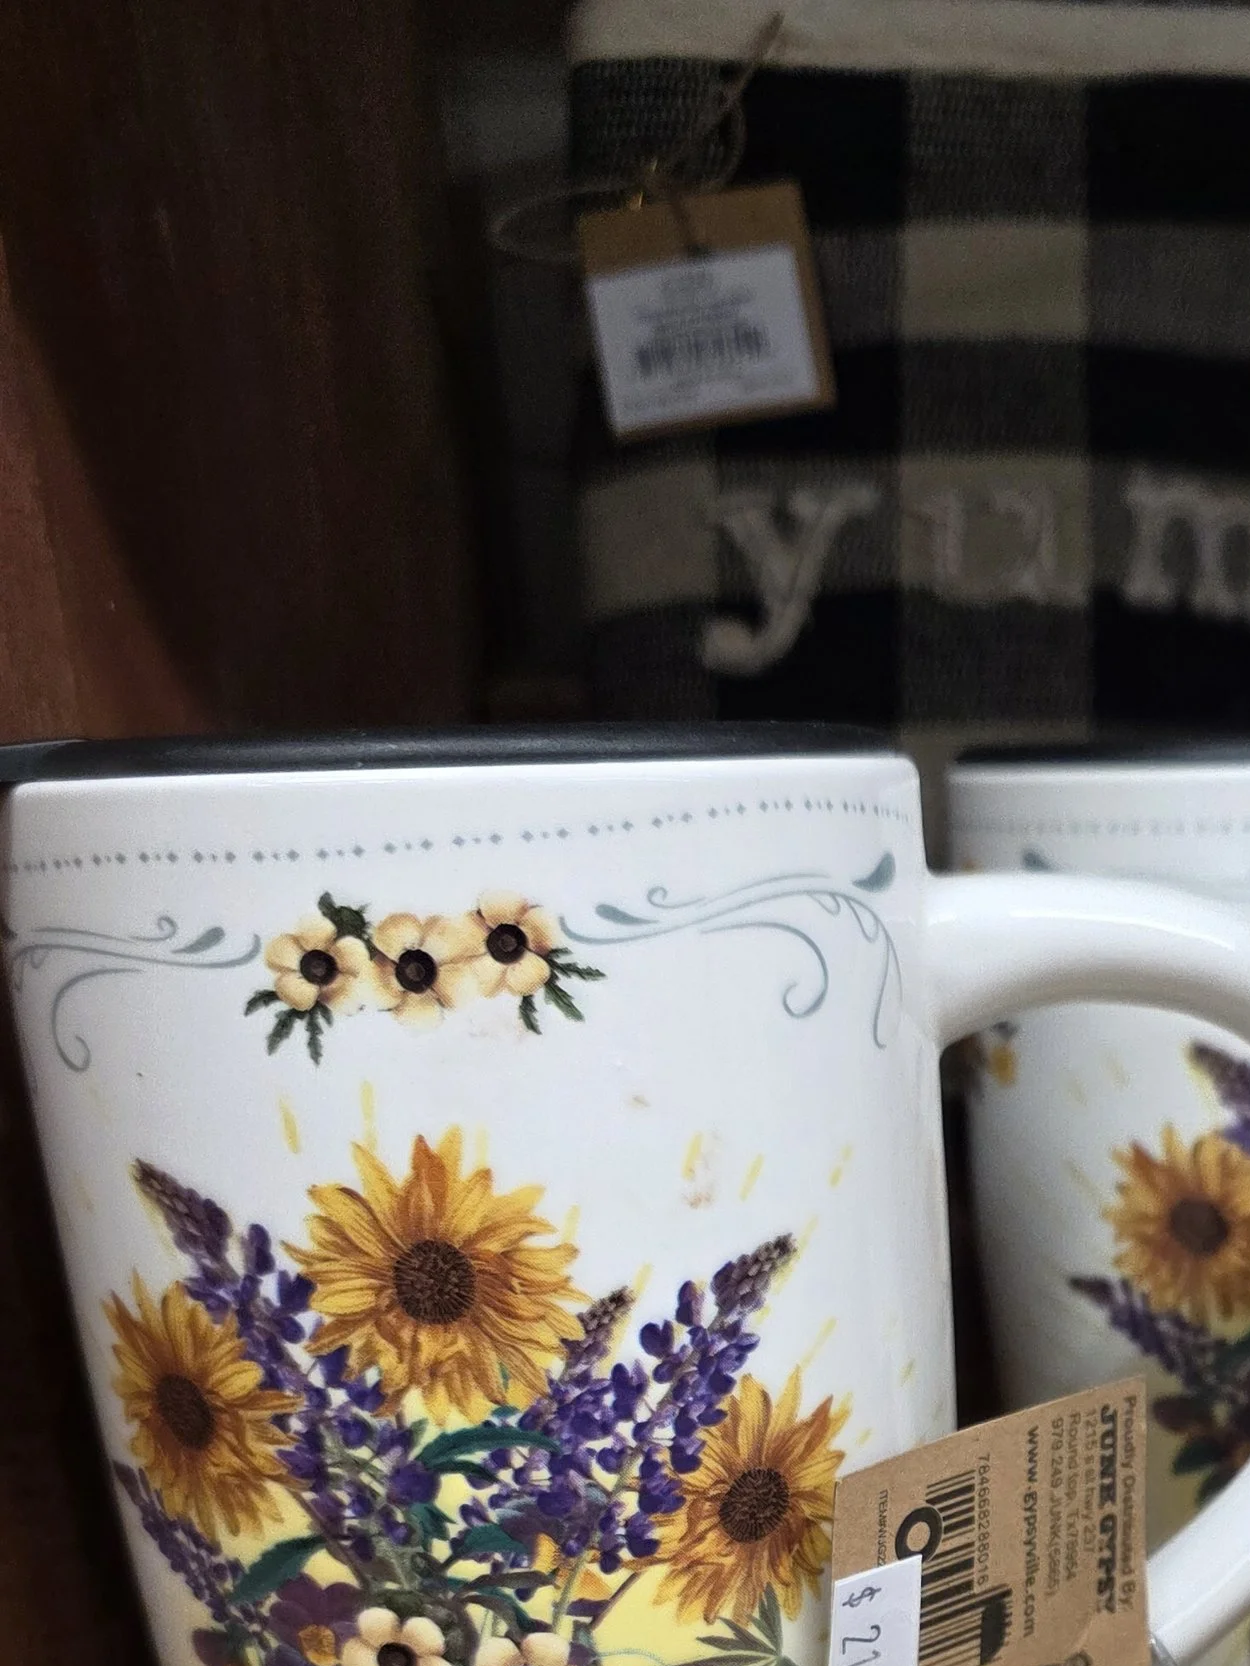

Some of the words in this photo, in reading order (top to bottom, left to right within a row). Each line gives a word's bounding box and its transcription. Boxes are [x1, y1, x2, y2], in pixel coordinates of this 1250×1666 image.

[1068, 1413, 1080, 1469] Round
[1085, 1409, 1097, 1450] 1215
[1099, 1405, 1118, 1508] JUNK
[1122, 1396, 1137, 1468] Proudly
[974, 1453, 990, 1587] 784668288016
[1023, 1426, 1039, 1636] www.gypsyville.com
[1096, 1514, 1118, 1614] GYPSY
[1121, 1476, 1136, 1575] Distributed
[842, 1586, 881, 1609] $
